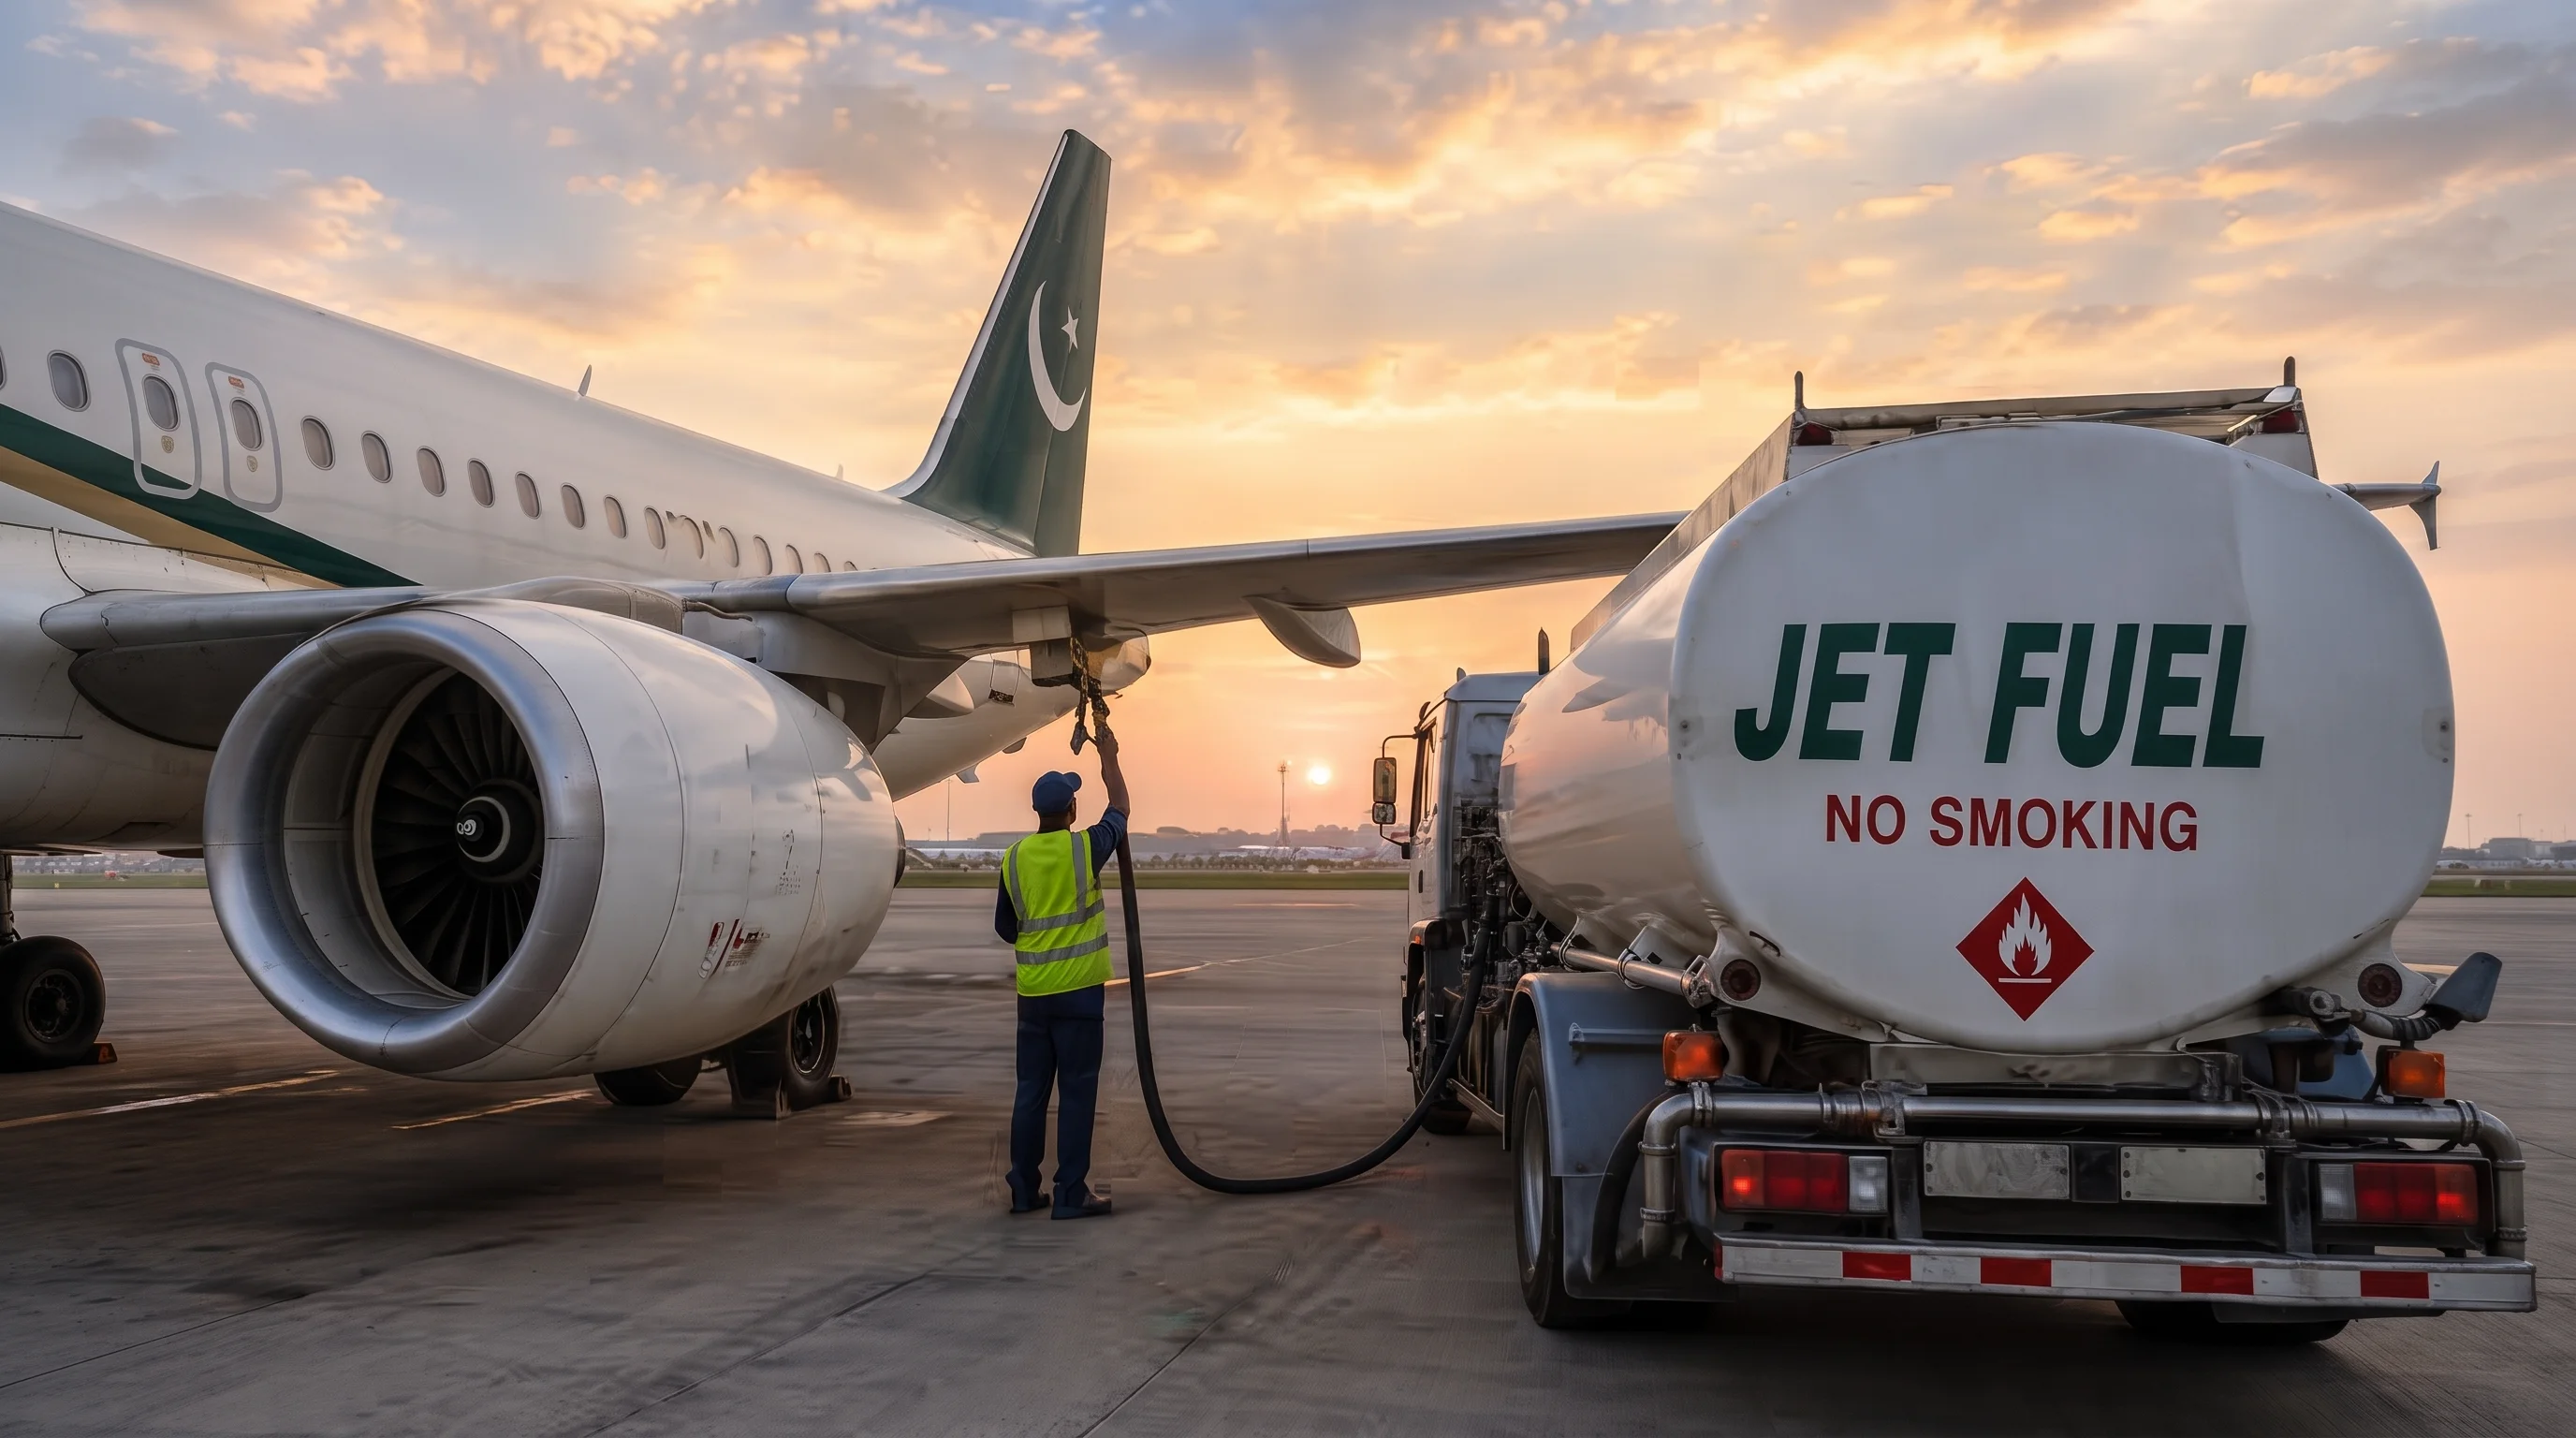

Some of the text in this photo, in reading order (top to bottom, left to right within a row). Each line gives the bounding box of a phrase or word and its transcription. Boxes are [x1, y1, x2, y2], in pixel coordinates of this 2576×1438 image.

[1734, 622, 2265, 769] JET FUEL
[1826, 794, 2198, 851] NO SMOKING
